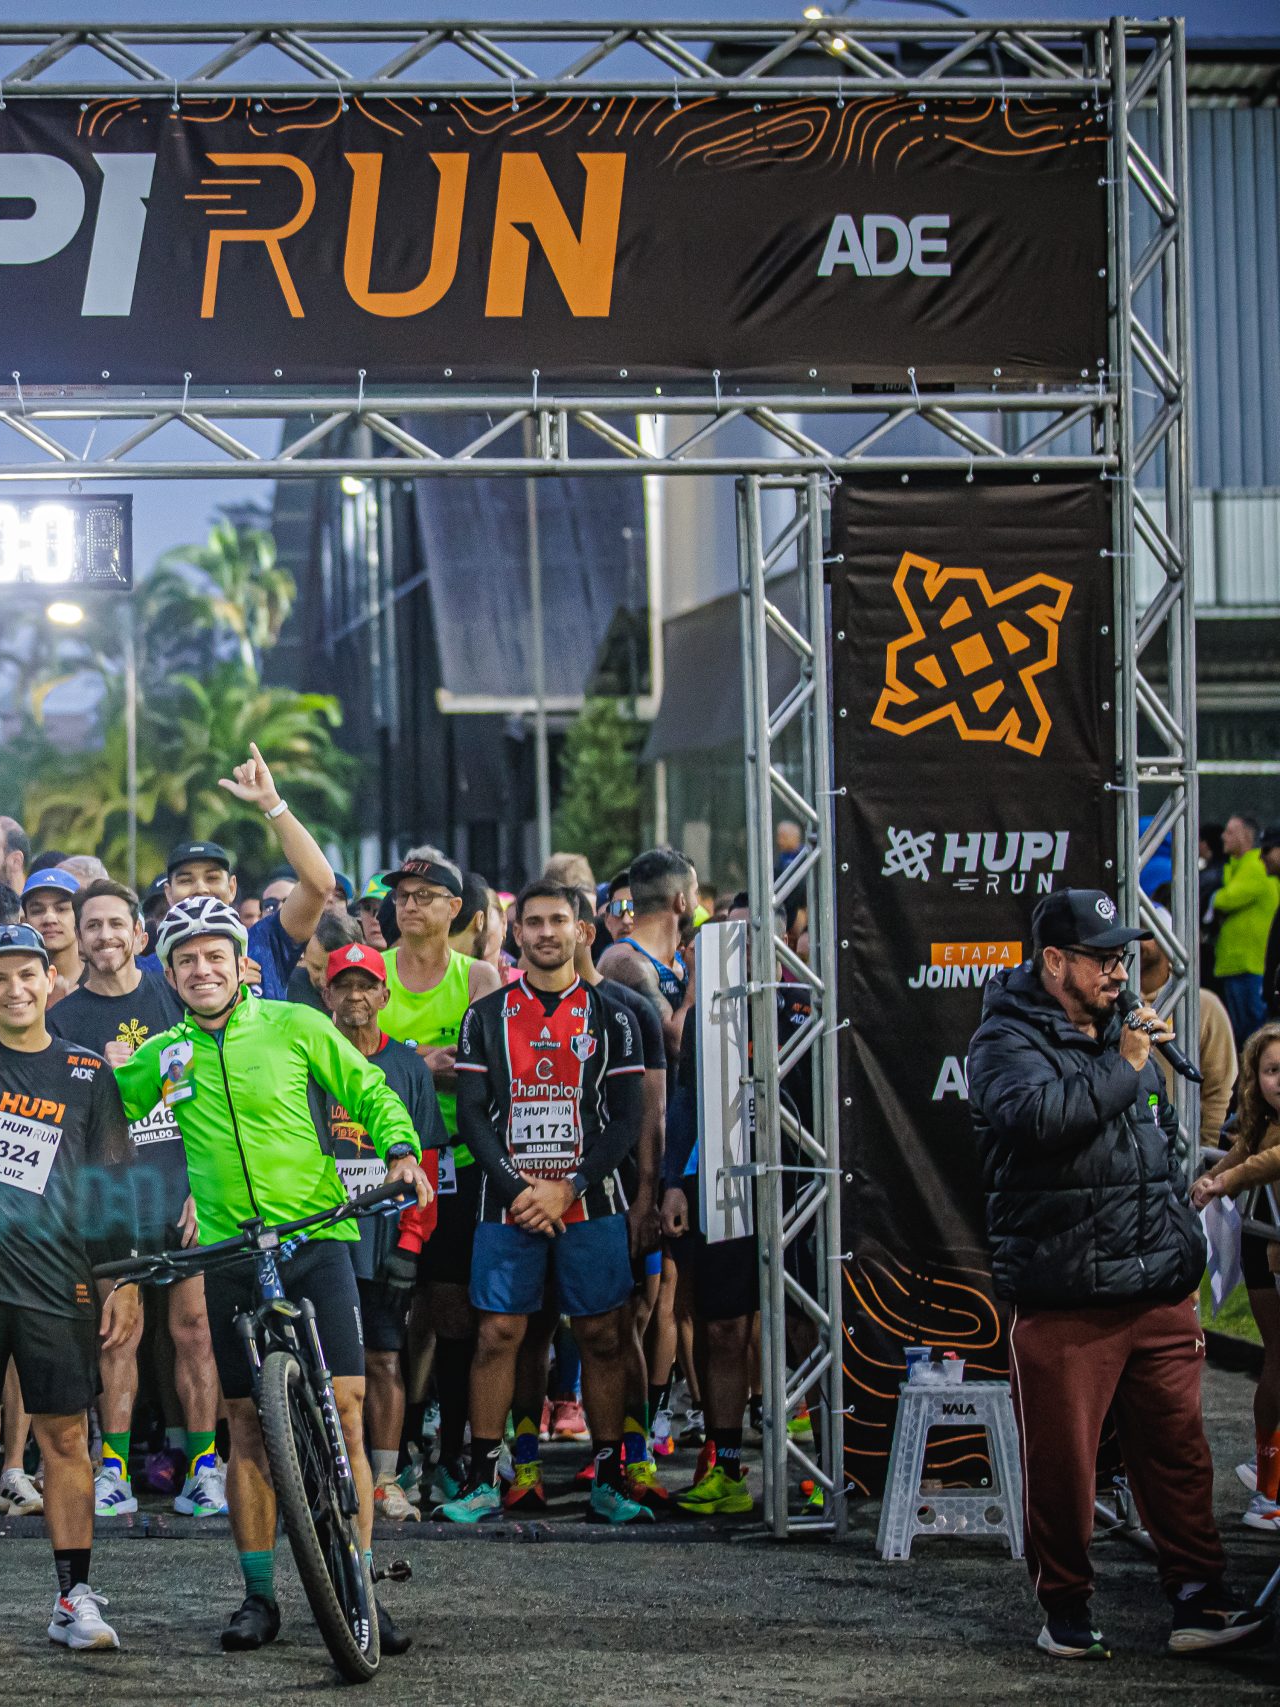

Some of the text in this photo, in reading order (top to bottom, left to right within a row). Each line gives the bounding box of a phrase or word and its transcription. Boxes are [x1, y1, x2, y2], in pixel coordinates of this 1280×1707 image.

[185, 152, 627, 319] RUN
[817, 214, 952, 277] ADE
[942, 831, 1070, 873] HUPI
[986, 873, 1053, 895] RUN
[944, 945, 1010, 961] ETAPA
[908, 963, 1022, 989] JOINVI
[81, 1057, 102, 1069] RUN
[70, 1067, 96, 1082] ADE
[509, 1078, 584, 1102] Champion
[523, 1105, 572, 1116] HUPI RUN
[1, 1119, 59, 1145] HUPI RUN
[133, 1129, 174, 1143] OMILDO
[523, 1123, 573, 1139] 1173
[526, 1143, 562, 1153] SIDNEI
[340, 1165, 388, 1176] HUPI RUN
